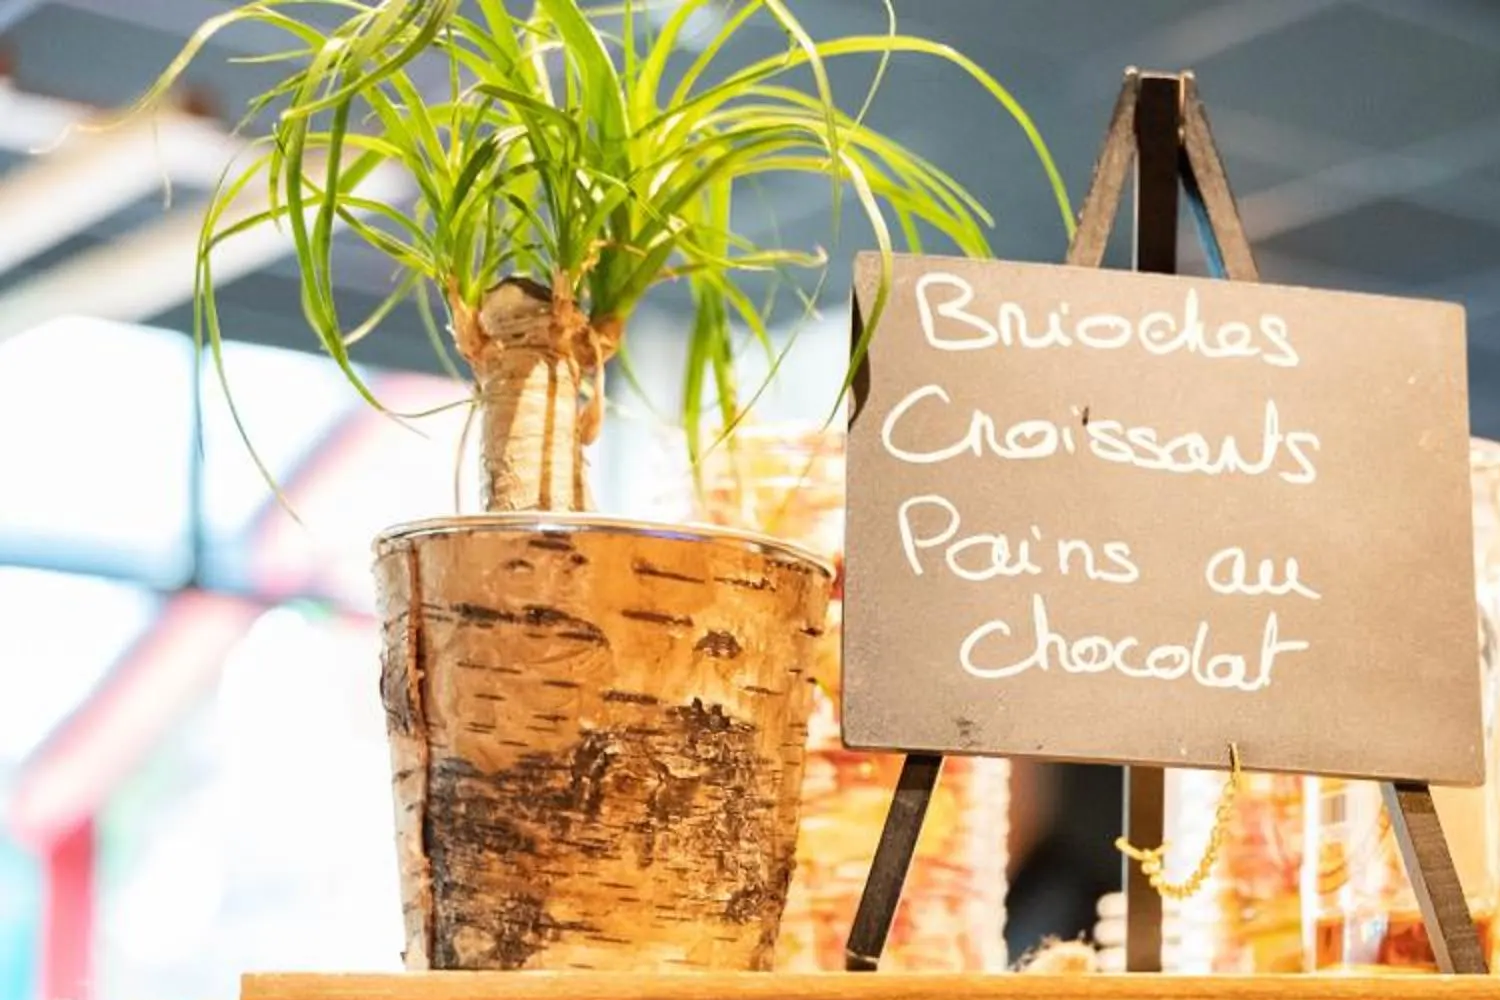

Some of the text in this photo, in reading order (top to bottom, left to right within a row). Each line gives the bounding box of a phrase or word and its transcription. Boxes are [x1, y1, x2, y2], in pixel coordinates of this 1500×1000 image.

[916, 273, 1300, 367] Brioches
[881, 385, 1321, 484] Croissants
[898, 495, 1321, 600] Pains au
[959, 595, 1309, 692] chocolat
